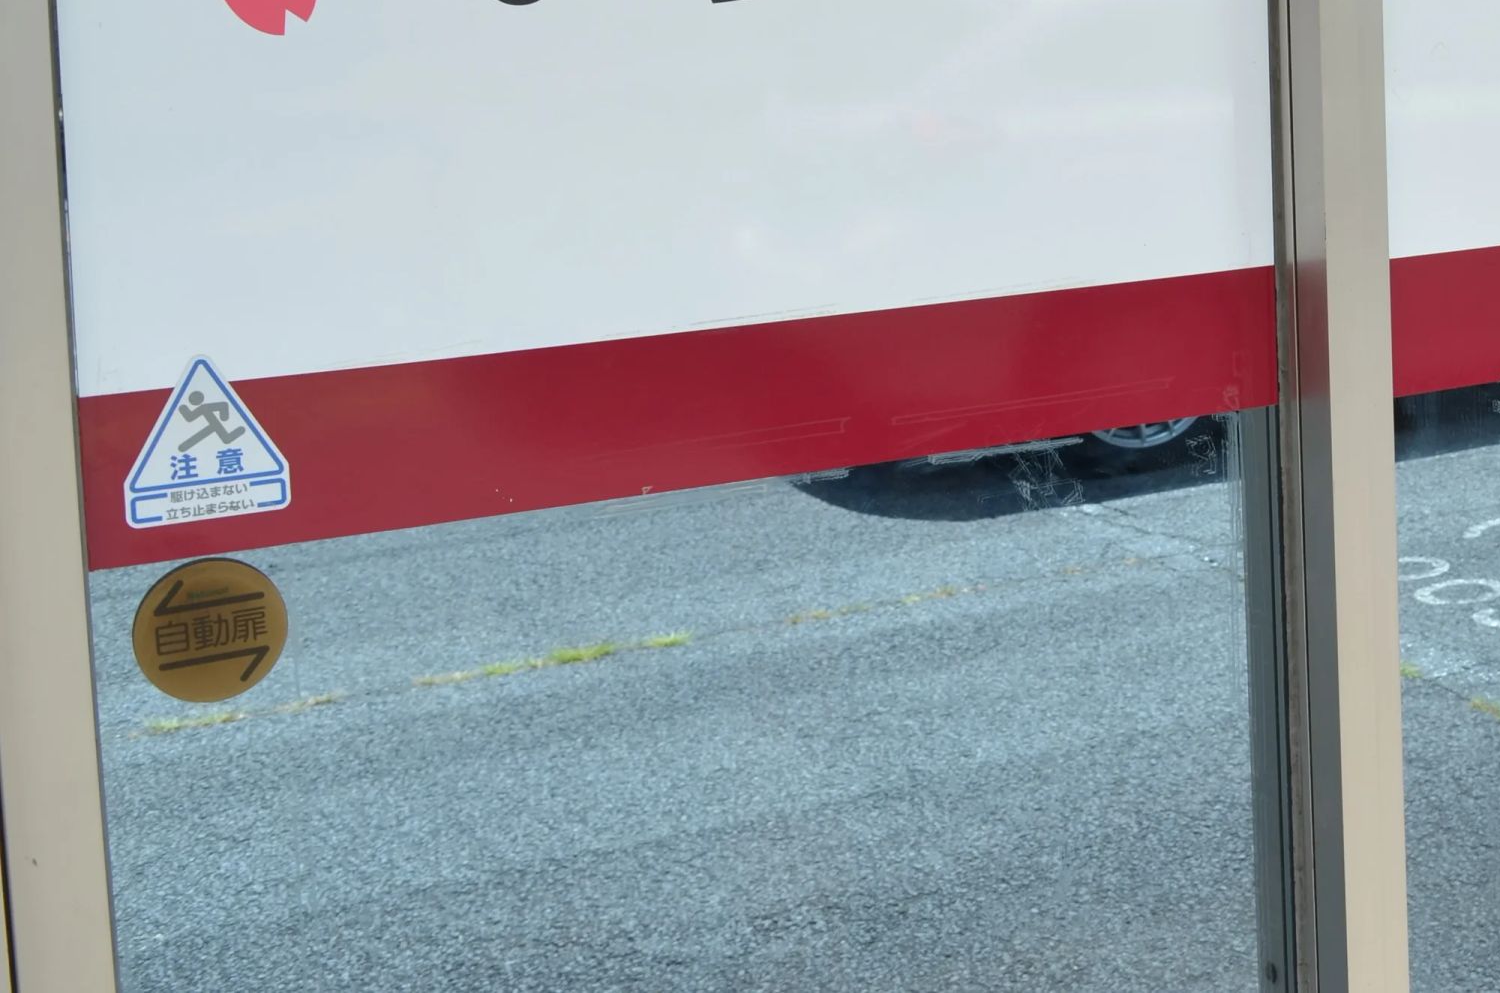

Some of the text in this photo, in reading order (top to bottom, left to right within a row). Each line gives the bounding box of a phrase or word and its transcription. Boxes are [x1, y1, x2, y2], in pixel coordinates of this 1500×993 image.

[170, 448, 244, 481] 注意
[170, 484, 248, 504] 駆け込まない
[166, 499, 255, 521] 立ち止まらない
[155, 605, 269, 657] 自動扉
